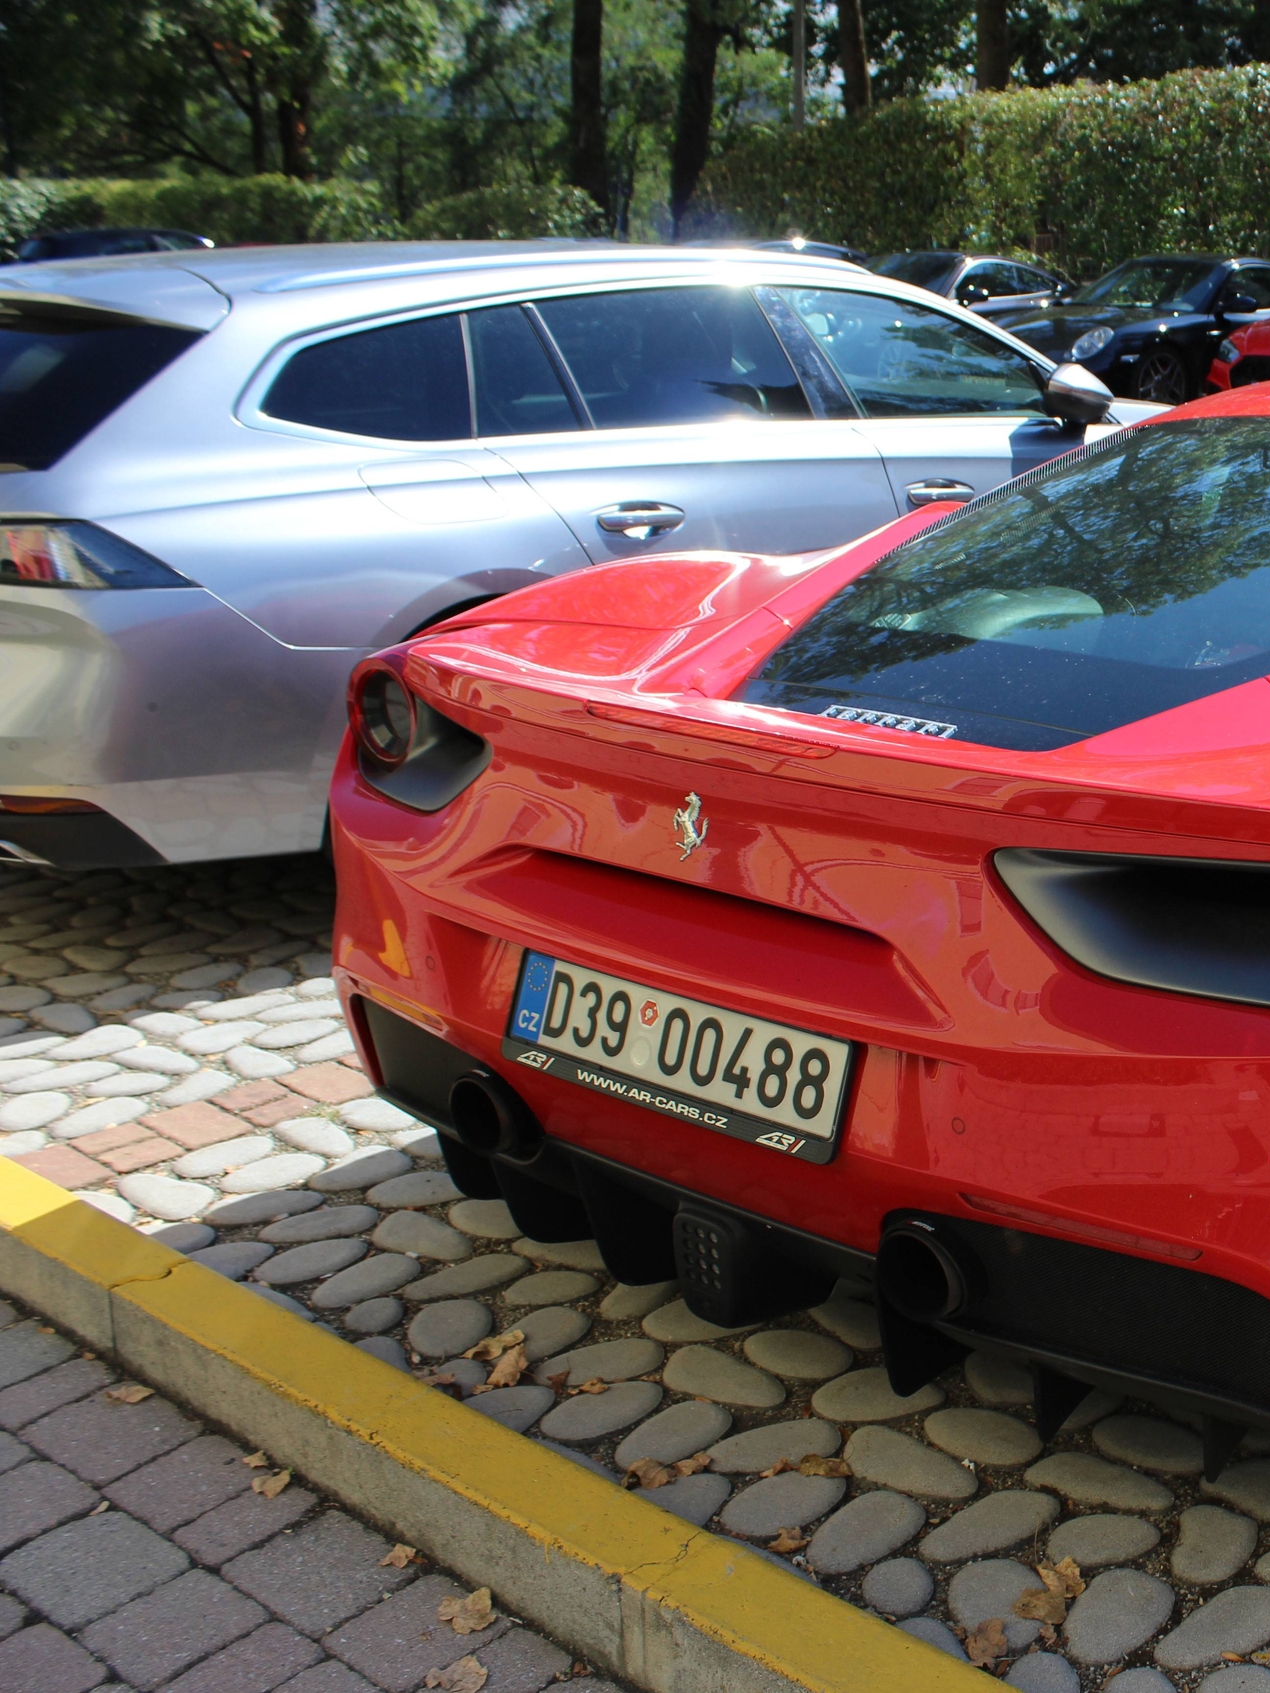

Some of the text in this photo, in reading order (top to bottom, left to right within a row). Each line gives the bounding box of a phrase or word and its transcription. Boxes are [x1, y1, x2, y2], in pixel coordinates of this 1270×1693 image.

[518, 1009, 540, 1032] CZ
[541, 970, 831, 1121] D39 00488
[577, 1069, 729, 1129] WWW.AR-CARS.CZ
